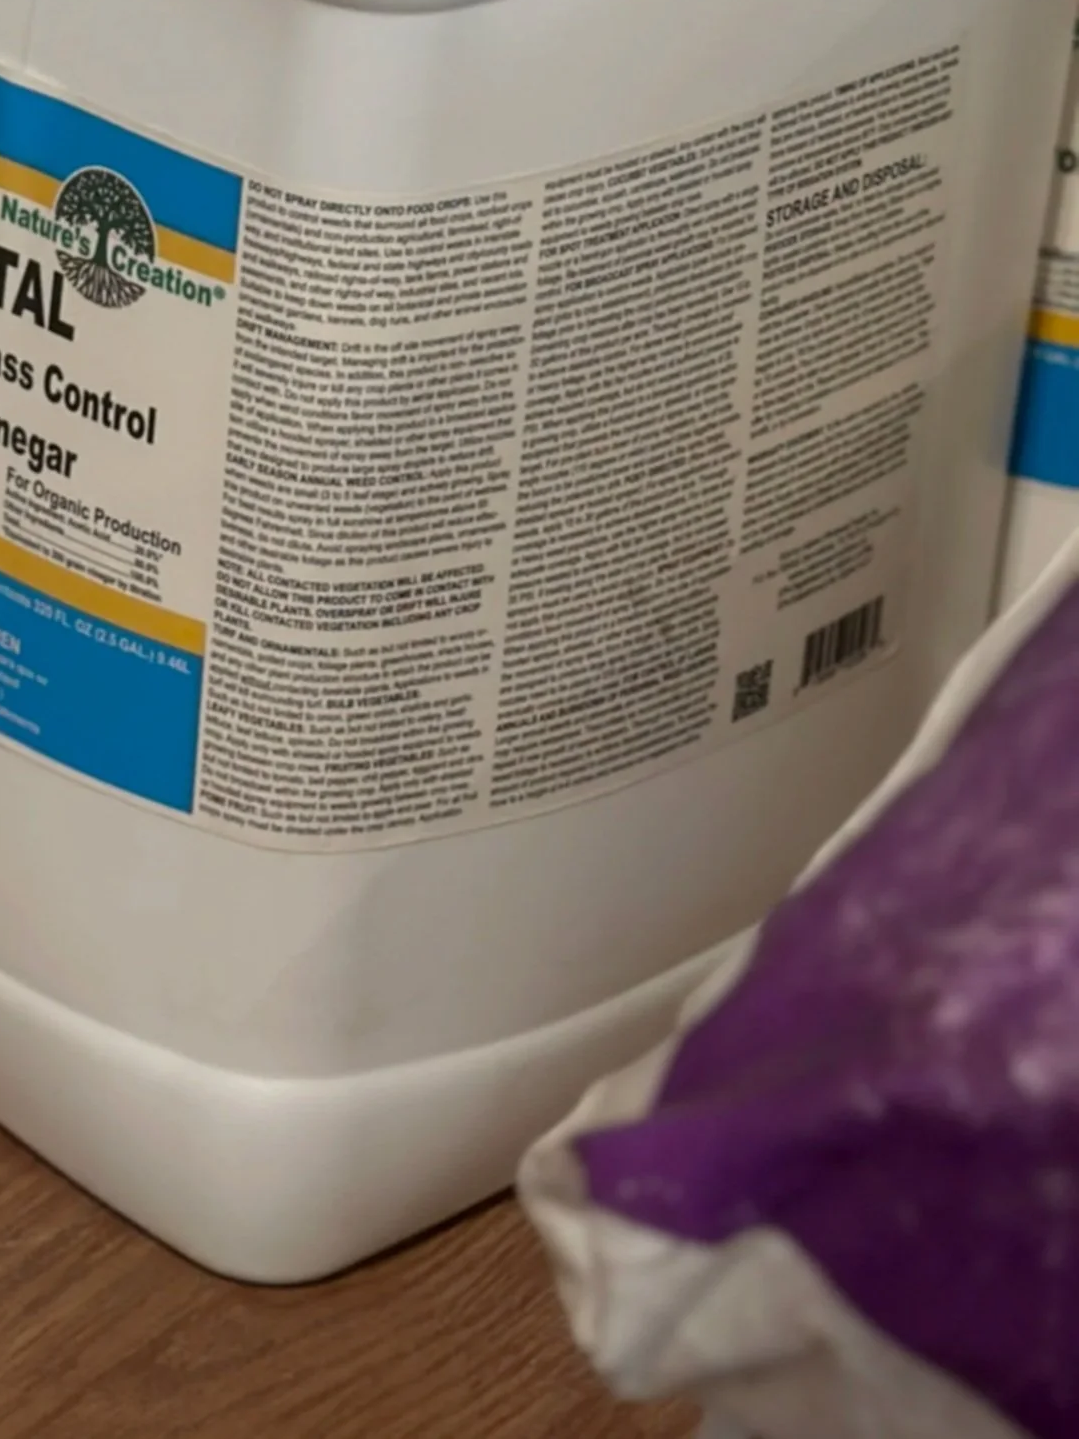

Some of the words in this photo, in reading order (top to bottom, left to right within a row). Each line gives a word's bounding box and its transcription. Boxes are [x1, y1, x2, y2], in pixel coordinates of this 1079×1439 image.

[248, 179, 262, 193] DO
[284, 191, 318, 208] SPRAY
[320, 199, 371, 215] DIRECTLY
[373, 204, 404, 216] ONTO
[406, 201, 434, 215] FOOD
[766, 187, 830, 227] STORAGE
[832, 176, 861, 203] AND
[0, 194, 92, 257] Nature's
[321, 217, 352, 228] weeds
[354, 219, 373, 230] that
[108, 246, 227, 307] Creation®
[43, 365, 157, 444] Control
[226, 451, 256, 469] EARLY
[257, 463, 299, 482] SEASON
[300, 473, 343, 487] ANNUAL
[346, 475, 377, 487] WEED
[5, 466, 30, 492] For
[33, 479, 91, 521] Organic
[93, 506, 182, 557] Production
[216, 570, 231, 583] DO
[231, 577, 253, 590] NOT
[252, 583, 289, 600] ALLOW
[291, 592, 315, 604] THIS
[317, 594, 368, 606] PRODUCT
[370, 592, 384, 604] TO
[426, 578, 471, 595] CONTACT
[247, 568, 265, 583] ALL
[267, 574, 331, 593] CONTACTED
[332, 580, 395, 593] VEGETATION
[396, 574, 418, 586] WILL
[421, 571, 434, 583] BE
[215, 583, 268, 610] DESIRABLE
[315, 607, 378, 619] OVERSPRAY
[396, 599, 423, 613] DRIFT
[252, 609, 315, 631] CONTACTED
[317, 620, 381, 632] VEGETATION
[238, 633, 260, 647] AND
